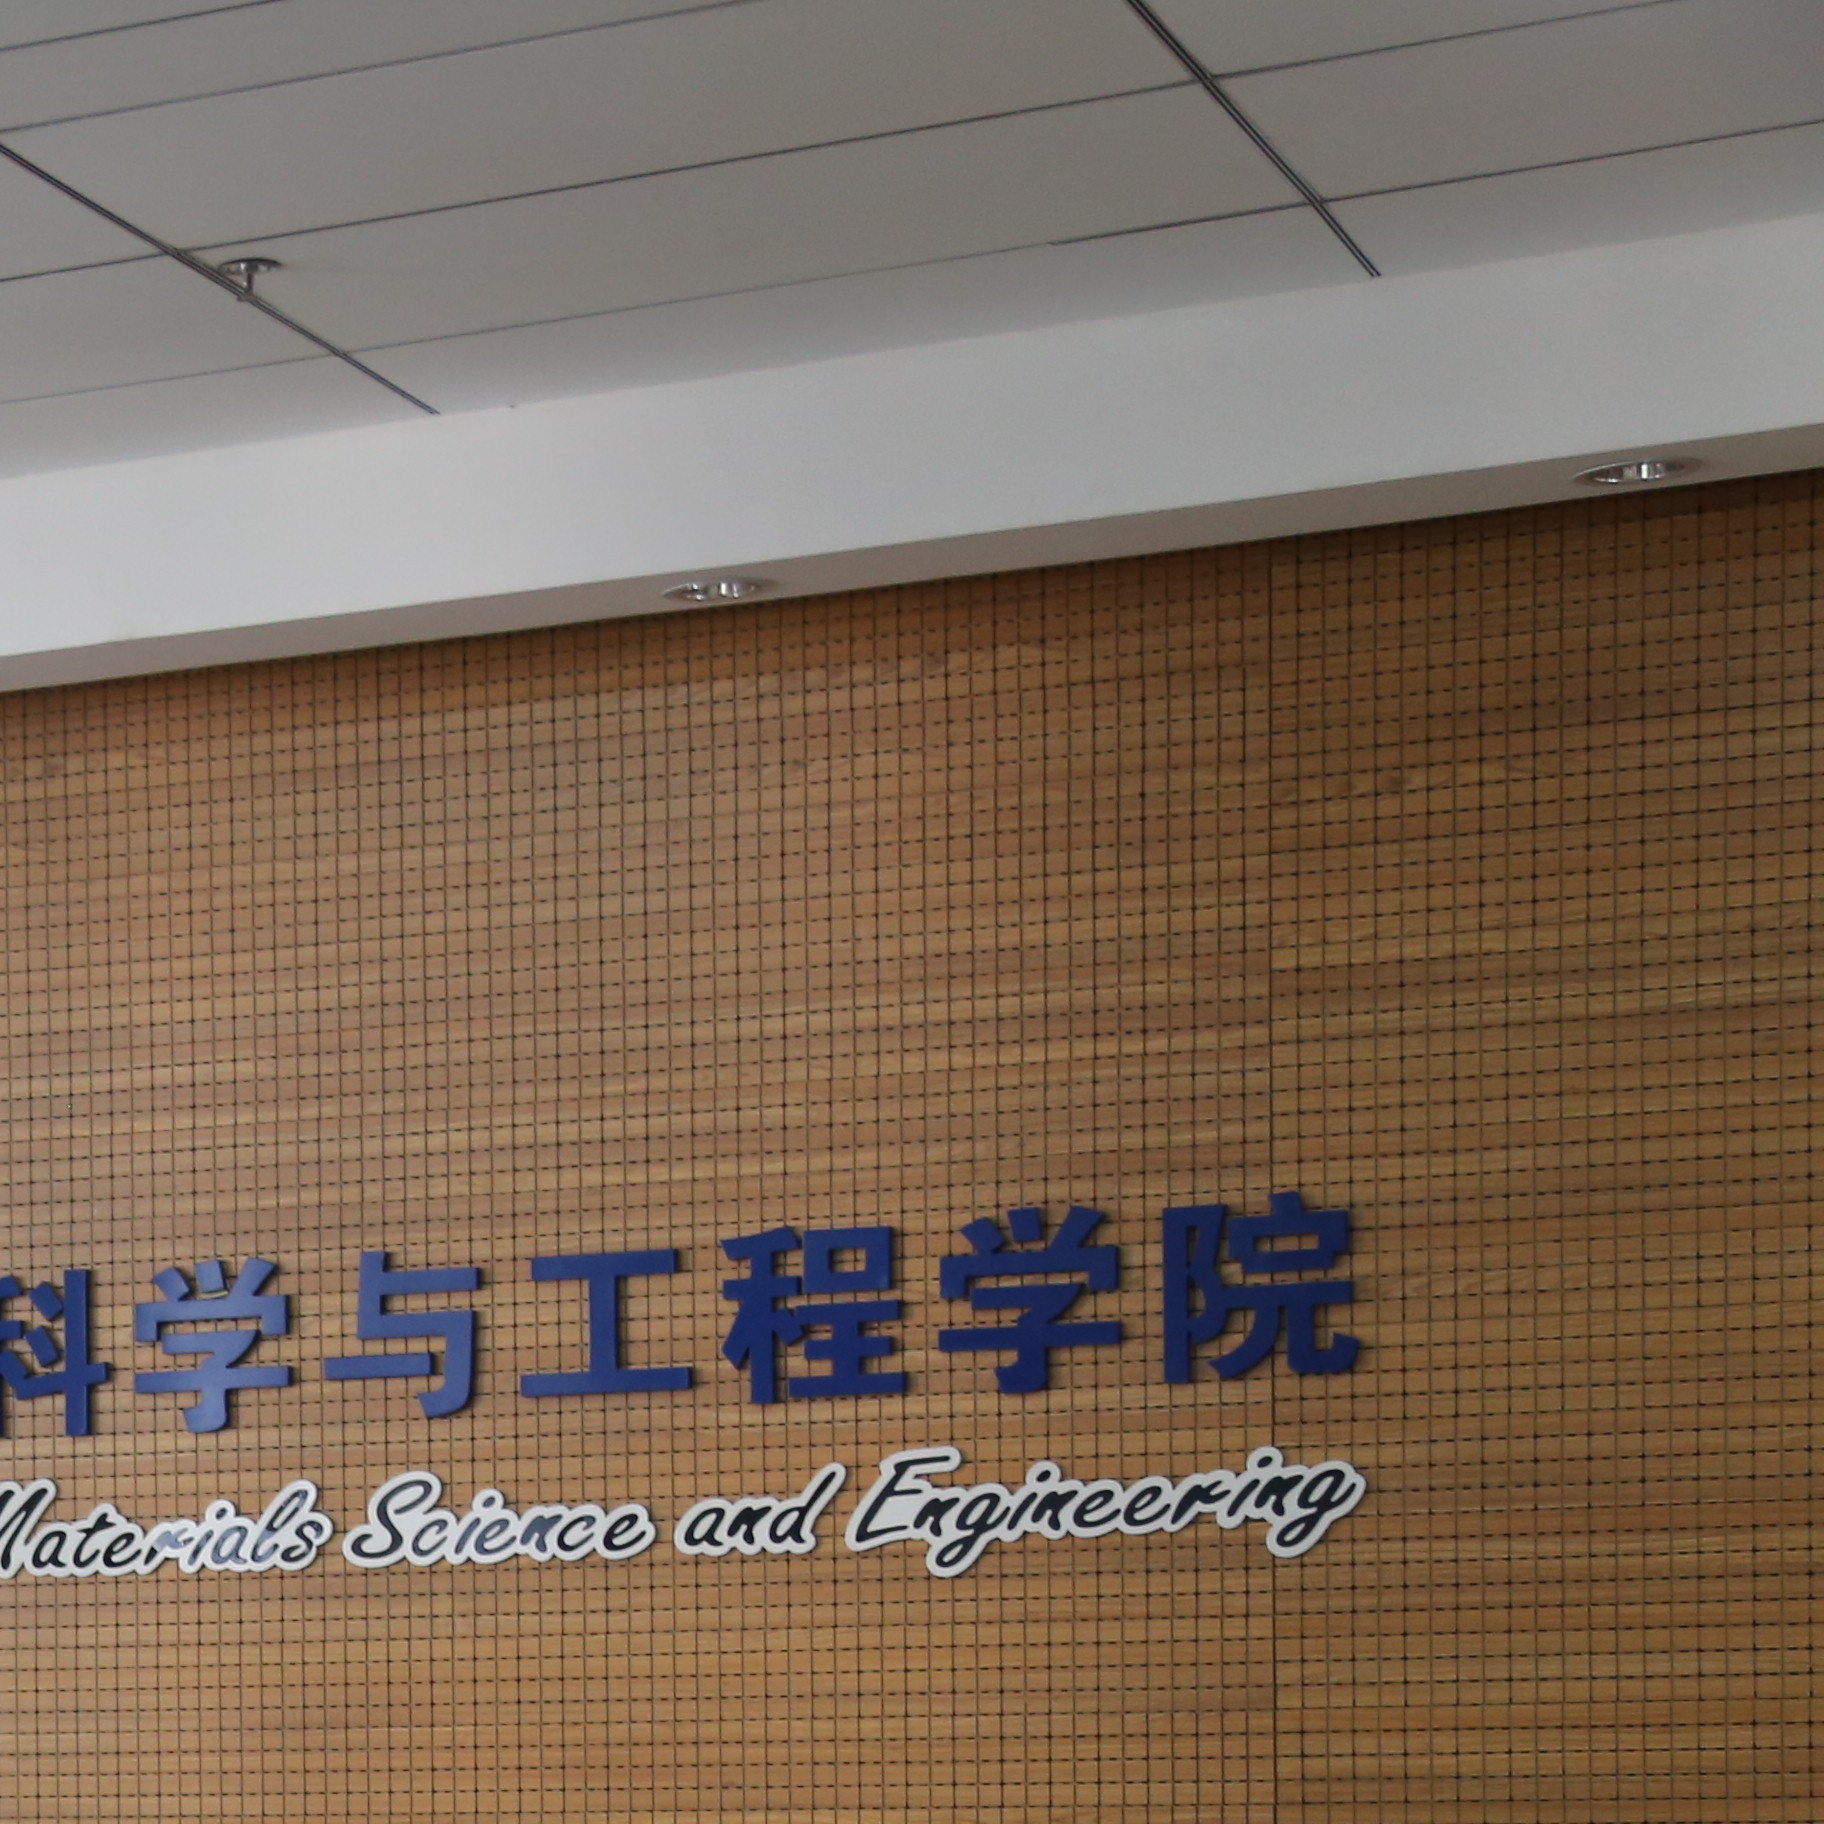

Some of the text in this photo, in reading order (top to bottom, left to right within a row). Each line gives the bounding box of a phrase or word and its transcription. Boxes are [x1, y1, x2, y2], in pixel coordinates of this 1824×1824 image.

[348, 1477, 649, 1560] Science
[682, 1468, 840, 1550] and
[853, 1453, 1360, 1571] Engineering
